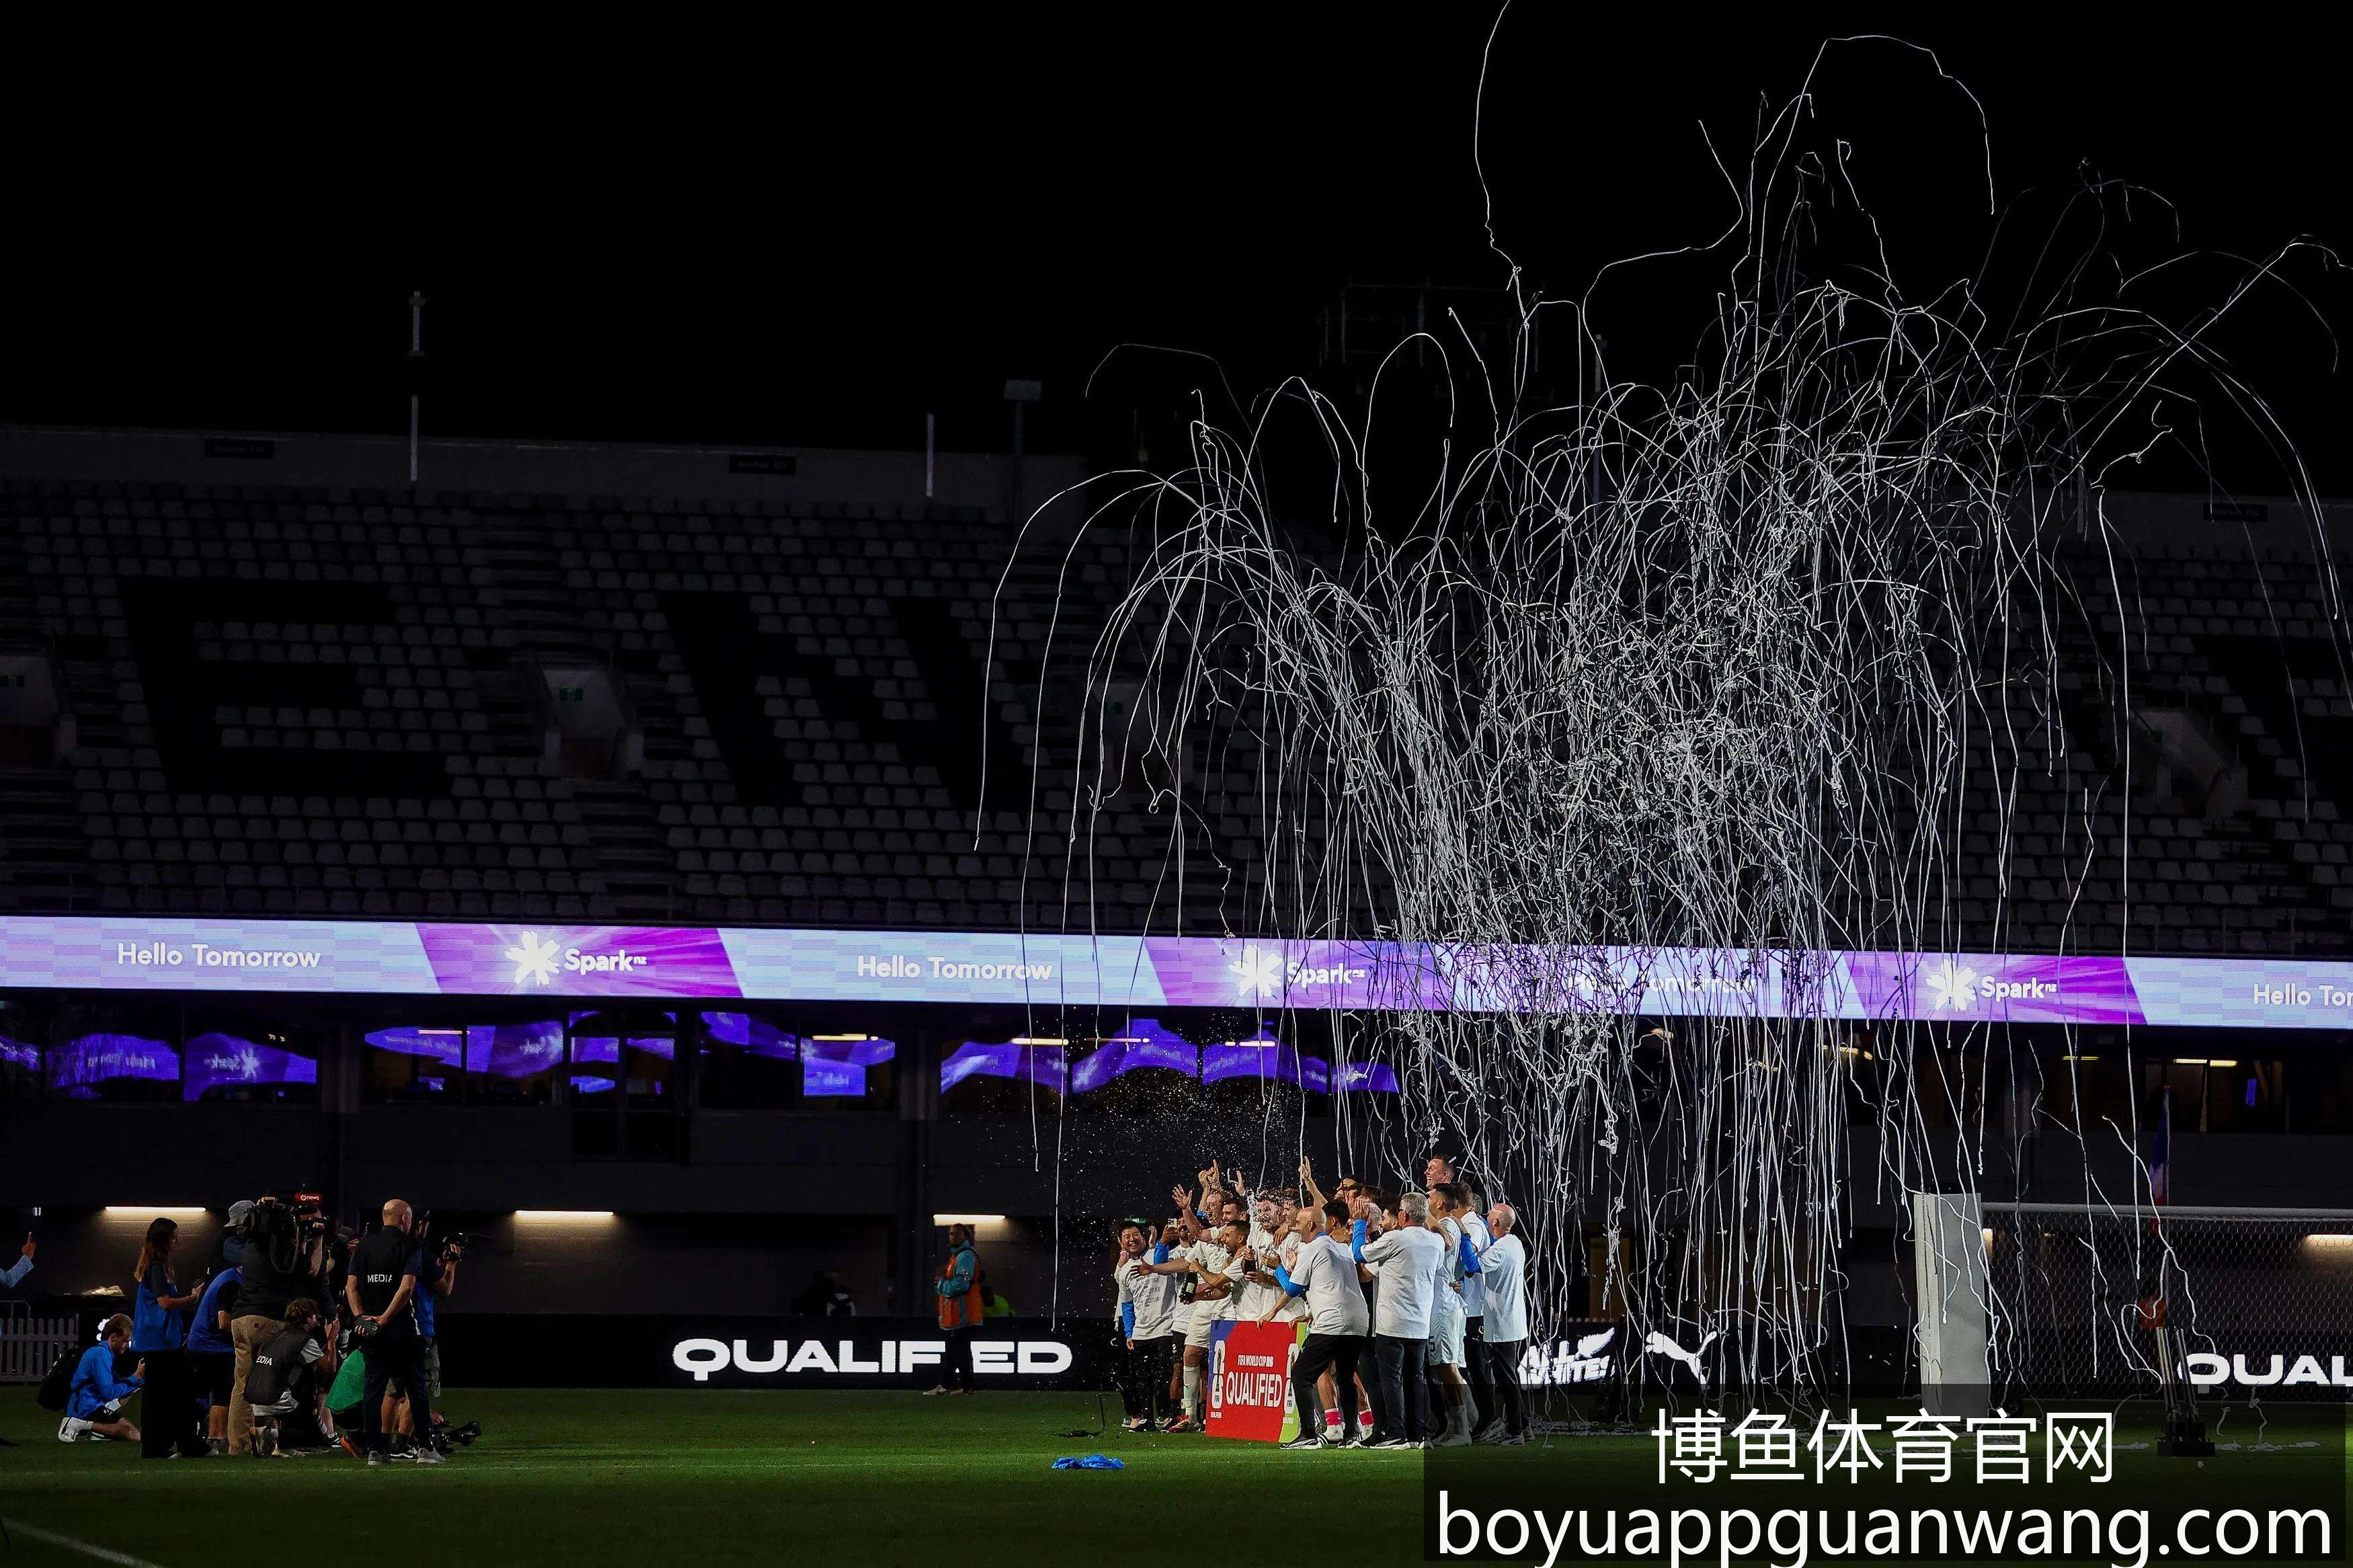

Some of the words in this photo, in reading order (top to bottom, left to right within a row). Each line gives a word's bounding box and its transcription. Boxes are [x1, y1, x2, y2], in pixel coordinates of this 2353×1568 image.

[118, 942, 182, 966] Hello
[192, 943, 321, 968] Tomorrow
[565, 949, 633, 975] Spark
[857, 955, 920, 978] Hello
[928, 957, 1052, 980] Tomorrow
[1981, 976, 2044, 1001] Spark
[2254, 983, 2311, 1007] Hello
[367, 1274, 393, 1283] MEDIA
[256, 1355, 273, 1366] EDIA
[672, 1338, 1073, 1381] QUALIFED
[1226, 1371, 1283, 1407] QUALIFIED
